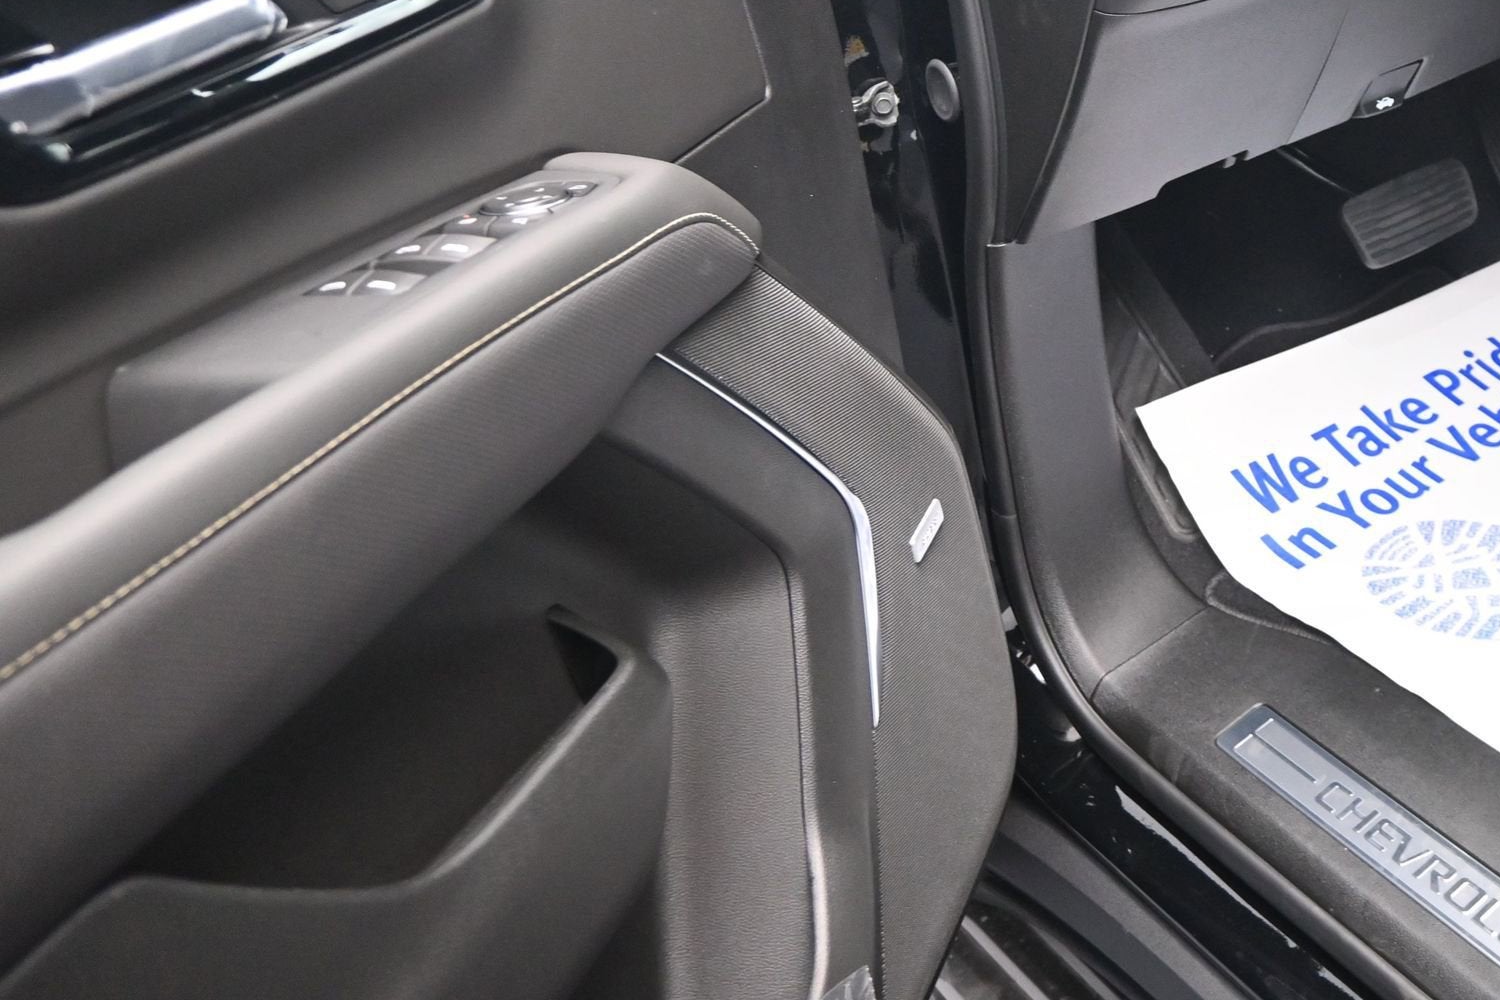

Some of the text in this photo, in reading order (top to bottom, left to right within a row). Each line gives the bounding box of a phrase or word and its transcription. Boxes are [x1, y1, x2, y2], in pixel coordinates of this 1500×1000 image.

[1230, 453, 1329, 514] We
[1310, 397, 1439, 467] Take
[1260, 533, 1337, 570] In
[1315, 455, 1445, 529] Your
